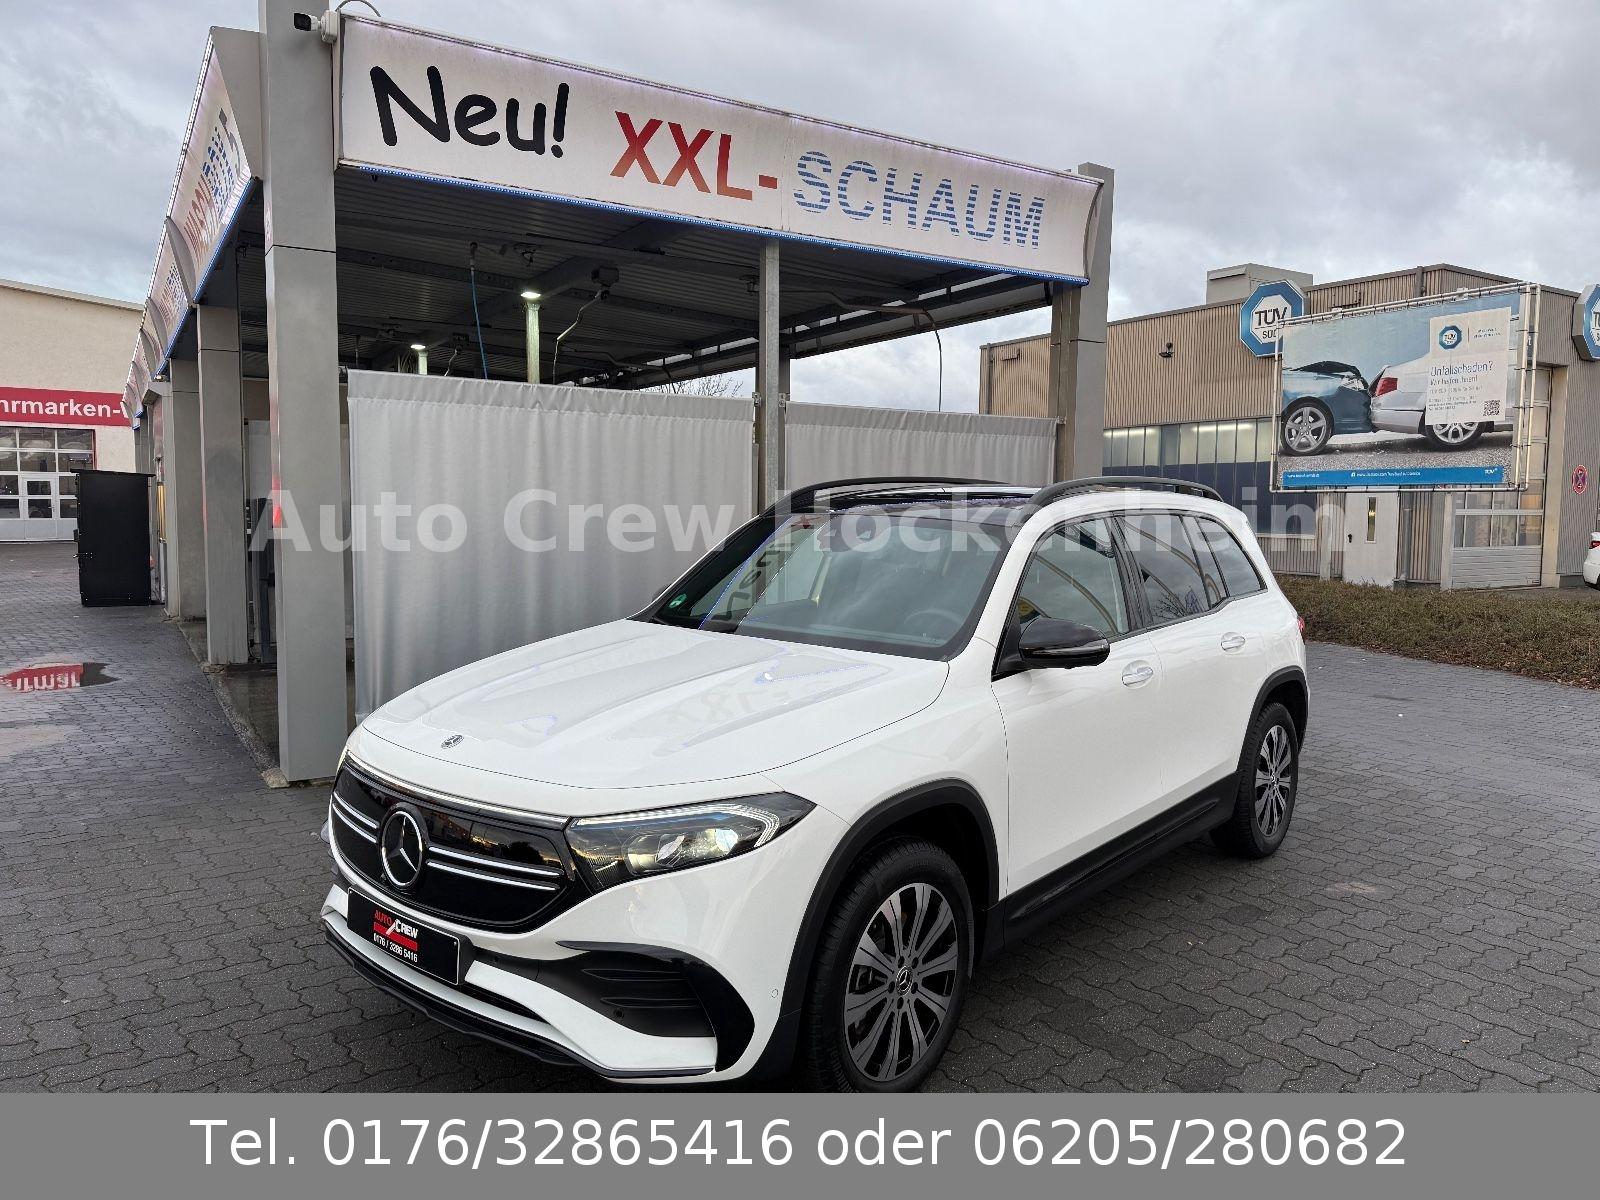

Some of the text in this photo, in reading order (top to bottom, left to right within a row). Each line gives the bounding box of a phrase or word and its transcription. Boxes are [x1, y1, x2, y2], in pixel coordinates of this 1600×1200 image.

[369, 65, 570, 159] Neu!
[1254, 307, 1287, 326] TÜV
[1430, 361, 1493, 376] Unfallschaden?
[374, 909, 419, 939] AUTO CREW
[373, 932, 386, 946] 0176
[389, 941, 403, 956] 3286
[403, 948, 418, 963] 5416
